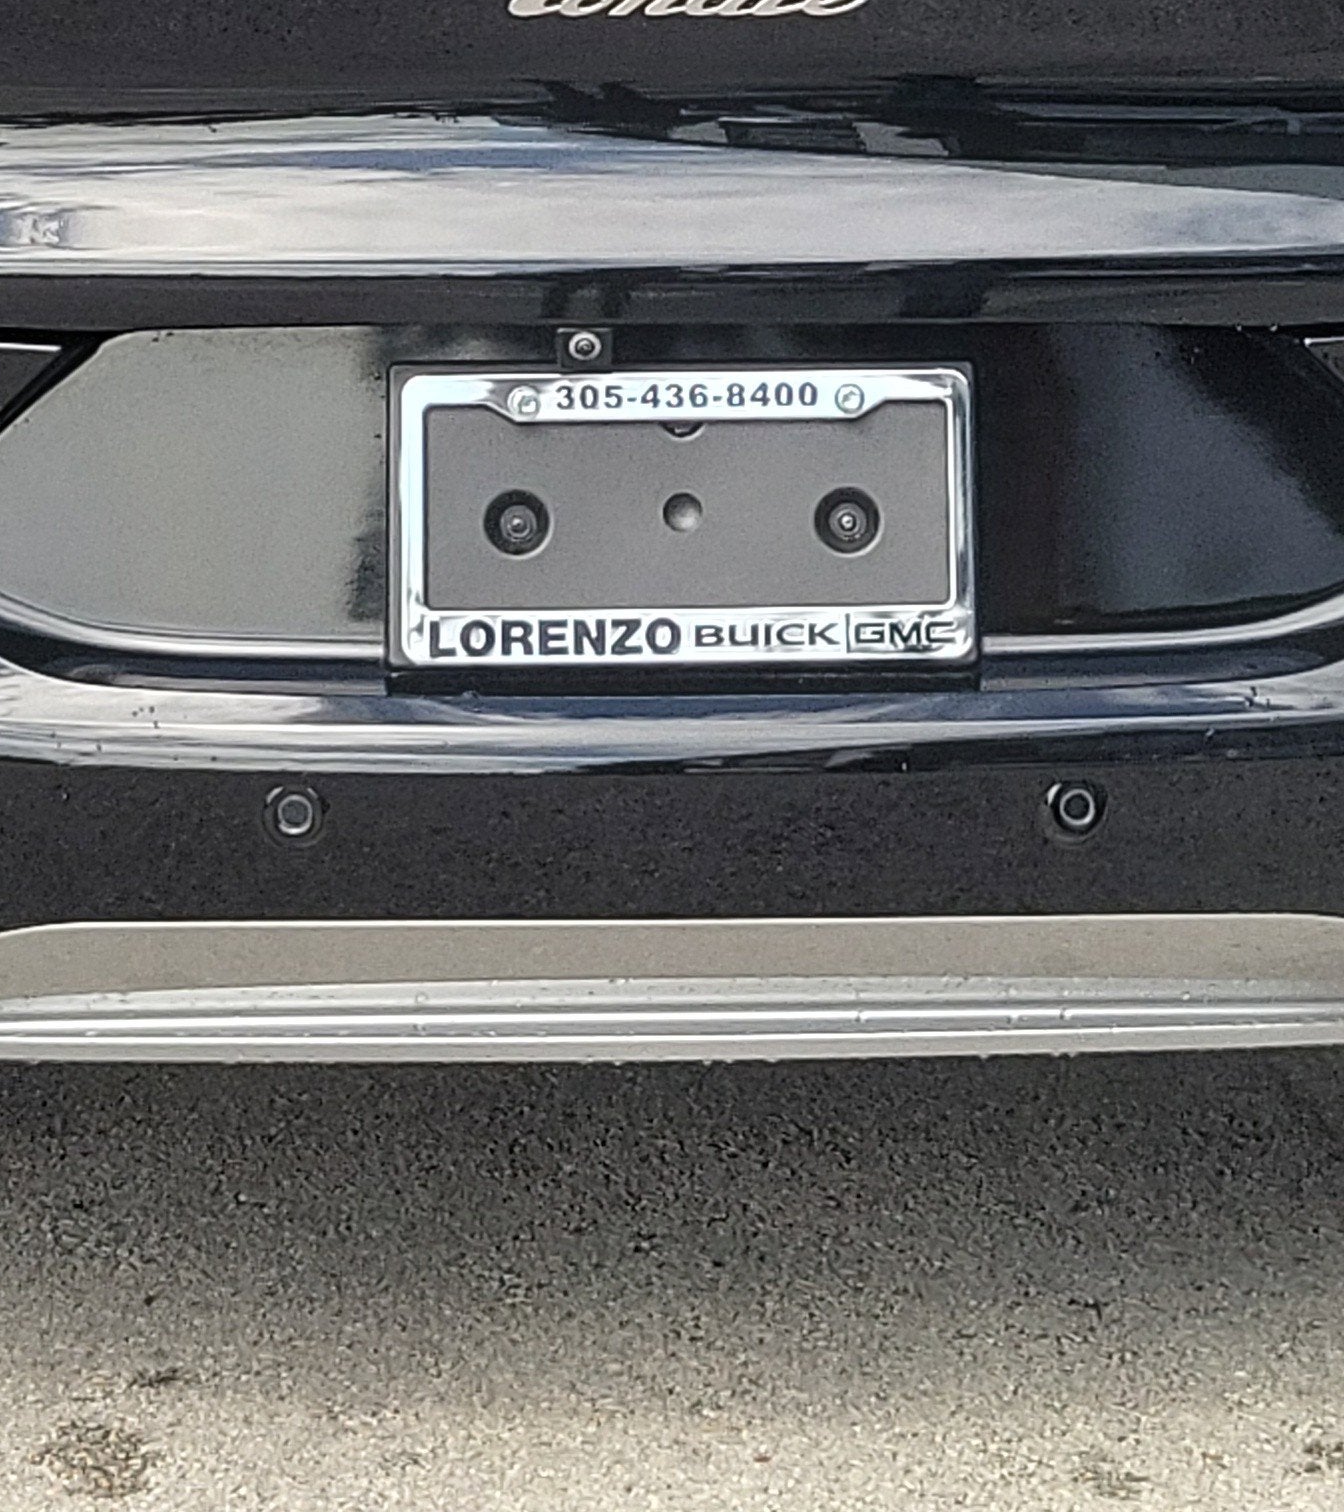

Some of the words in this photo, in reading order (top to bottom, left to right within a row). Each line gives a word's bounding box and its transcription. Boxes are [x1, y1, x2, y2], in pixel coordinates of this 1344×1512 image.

[556, 381, 819, 410] 305-436-8400
[428, 618, 682, 656] LORENZO
[694, 621, 843, 648] BUICK
[854, 619, 956, 644] GMC
